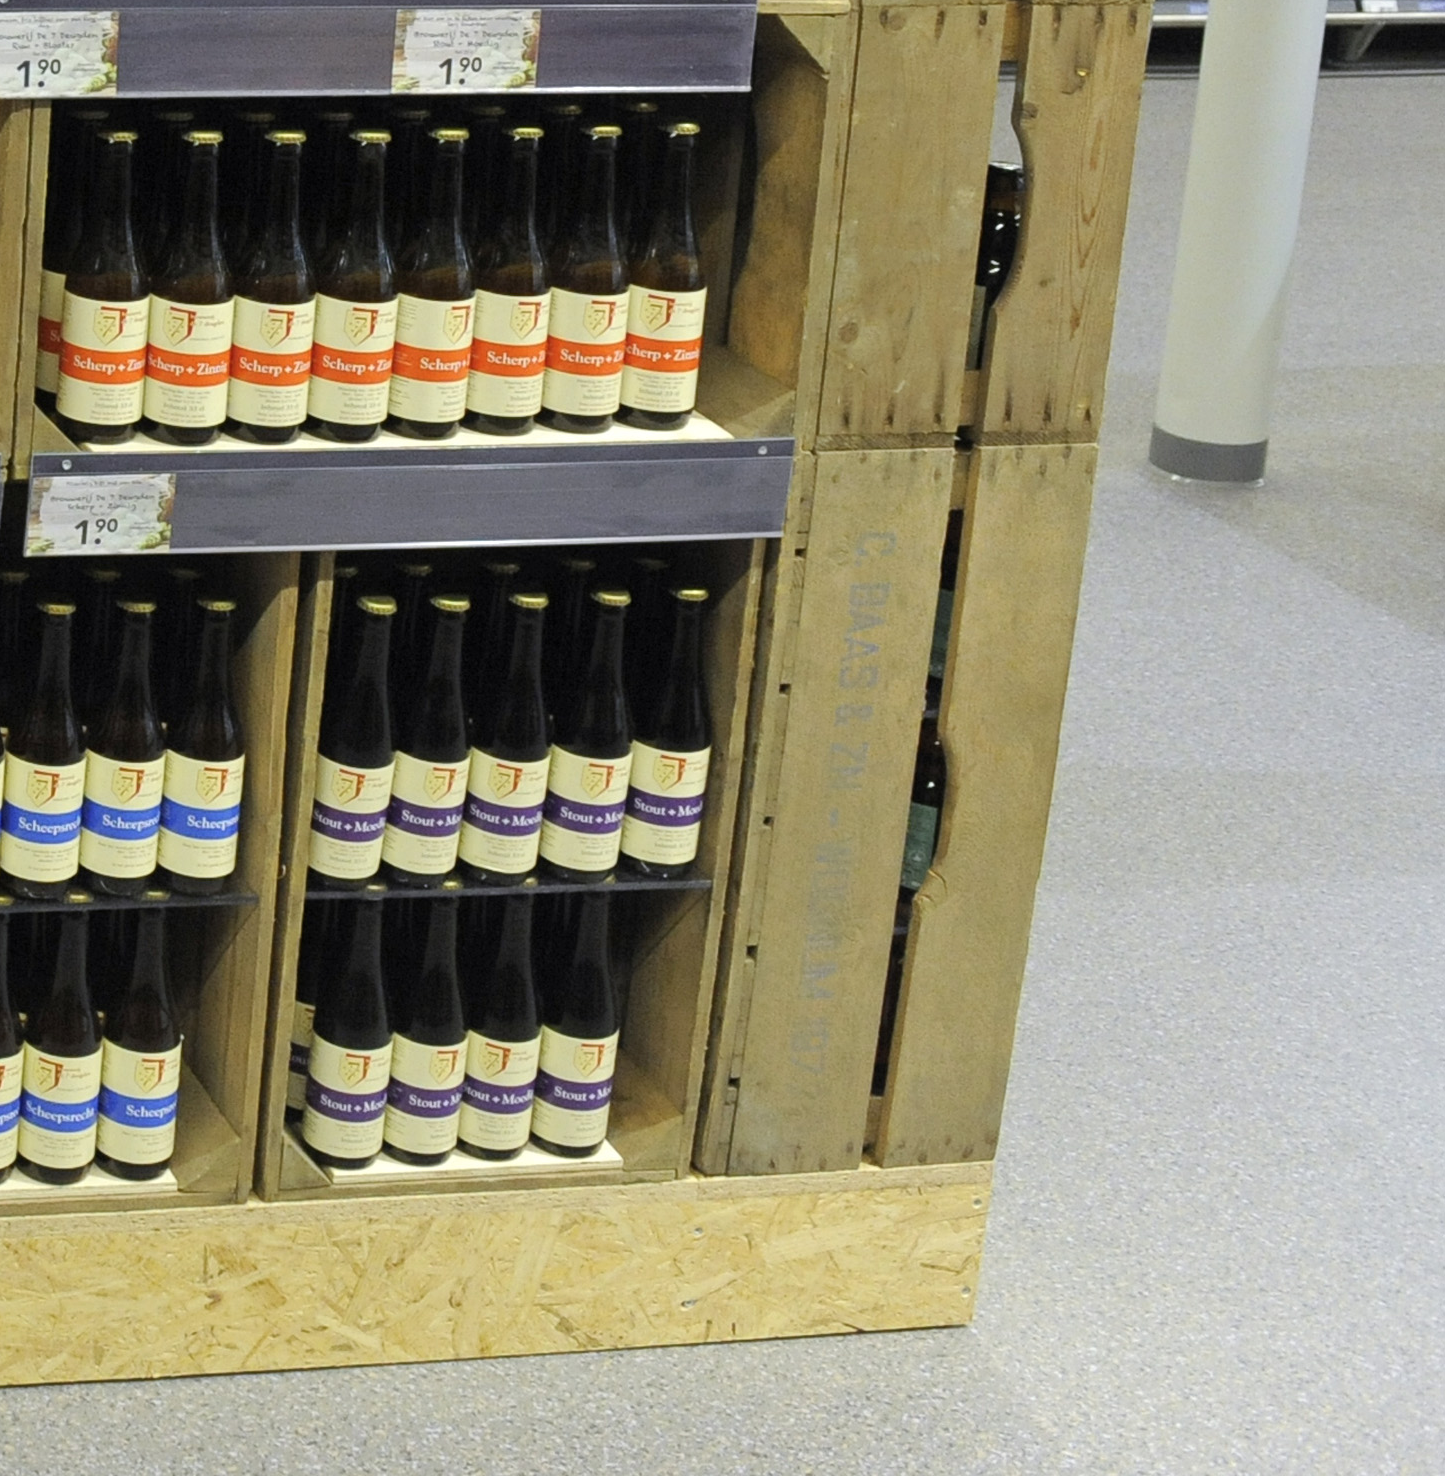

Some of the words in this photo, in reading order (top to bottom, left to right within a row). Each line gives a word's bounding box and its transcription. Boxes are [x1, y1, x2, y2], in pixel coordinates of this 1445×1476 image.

[72, 354, 114, 377] Scherp
[322, 356, 364, 378] Scherp
[837, 582, 892, 691] BAAS
[401, 809, 437, 826] Stout
